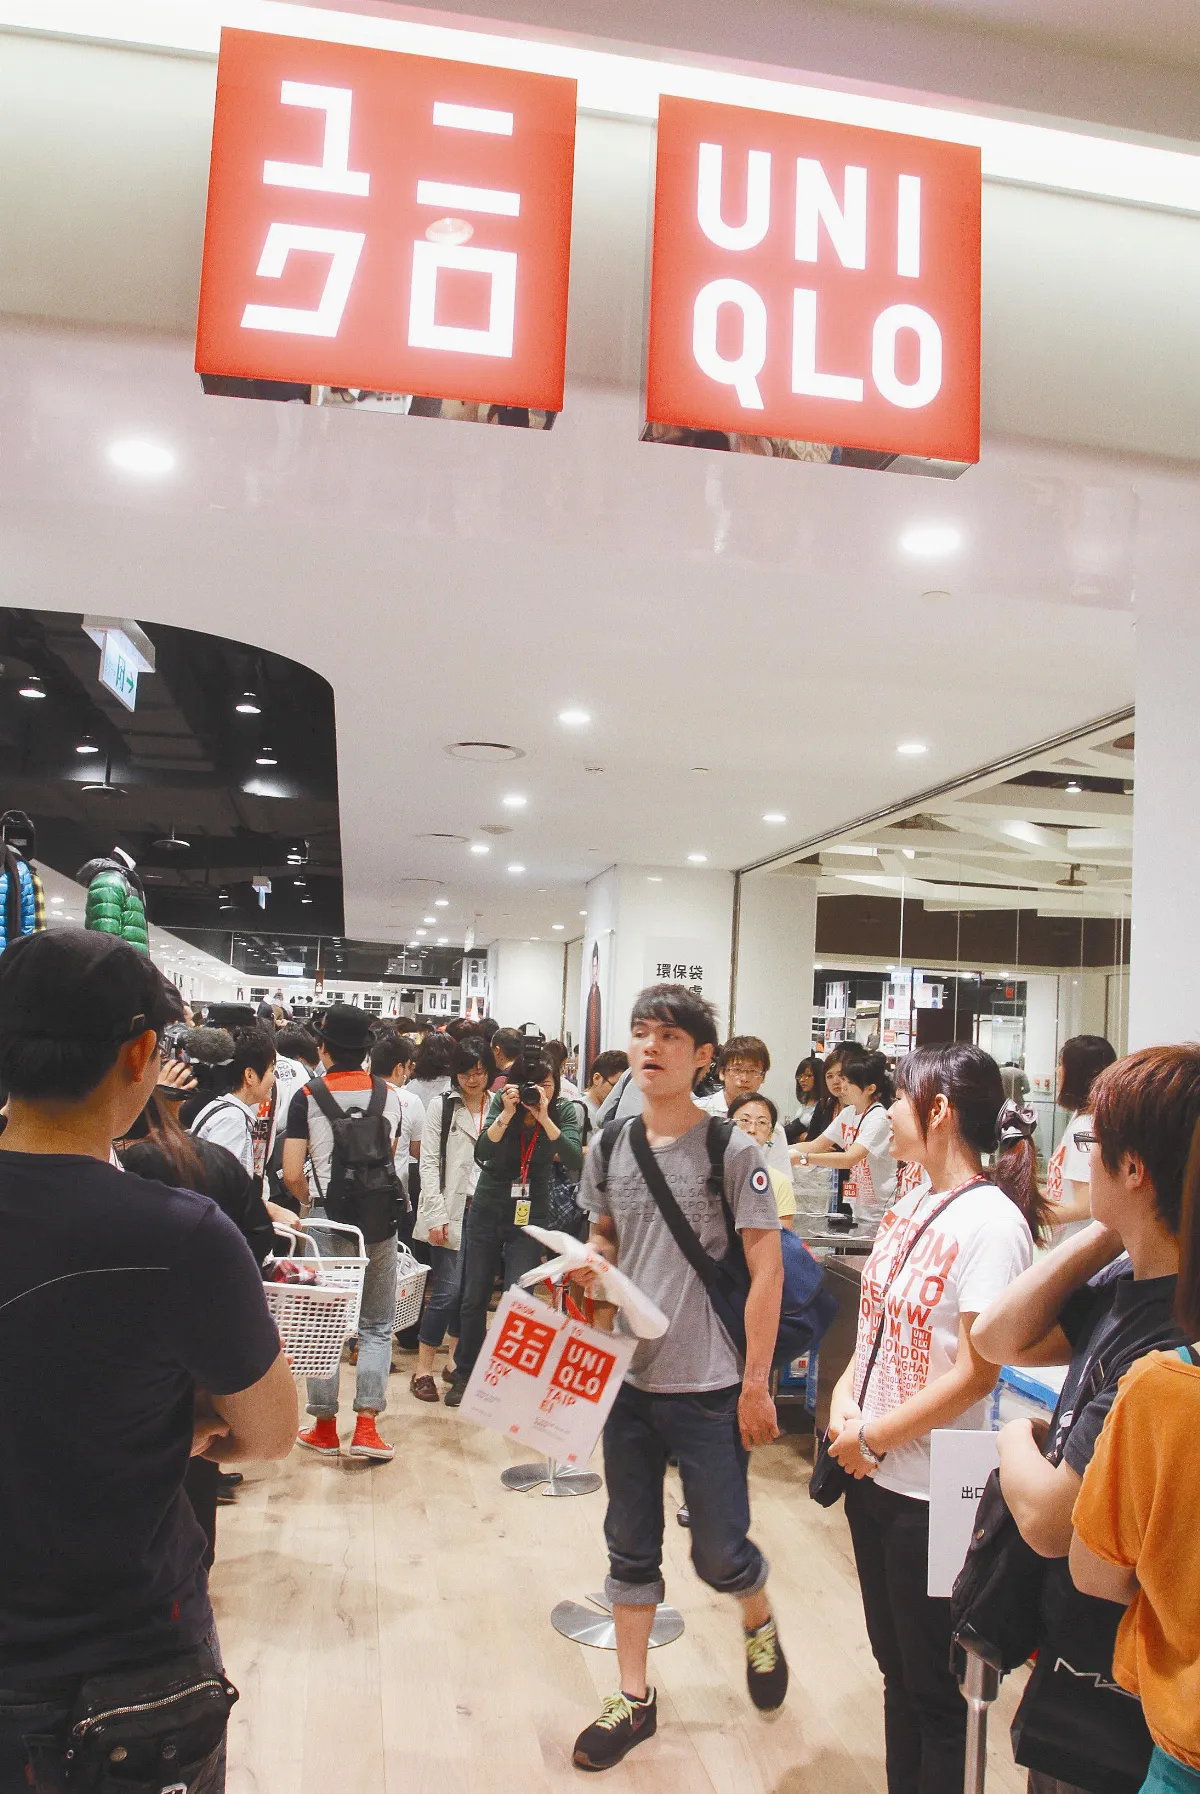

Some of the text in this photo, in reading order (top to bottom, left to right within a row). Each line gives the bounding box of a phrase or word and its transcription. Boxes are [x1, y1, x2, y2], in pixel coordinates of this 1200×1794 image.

[263, 80, 520, 216] ユニ
[697, 142, 921, 279] UNI
[240, 222, 518, 358] クロ
[692, 277, 942, 410] QLO
[656, 963, 703, 980] 環保袋
[506, 1319, 549, 1349] ユニ
[913, 1329, 929, 1339] UNI
[567, 1343, 607, 1376] UNI
[559, 1365, 601, 1396] QLO
